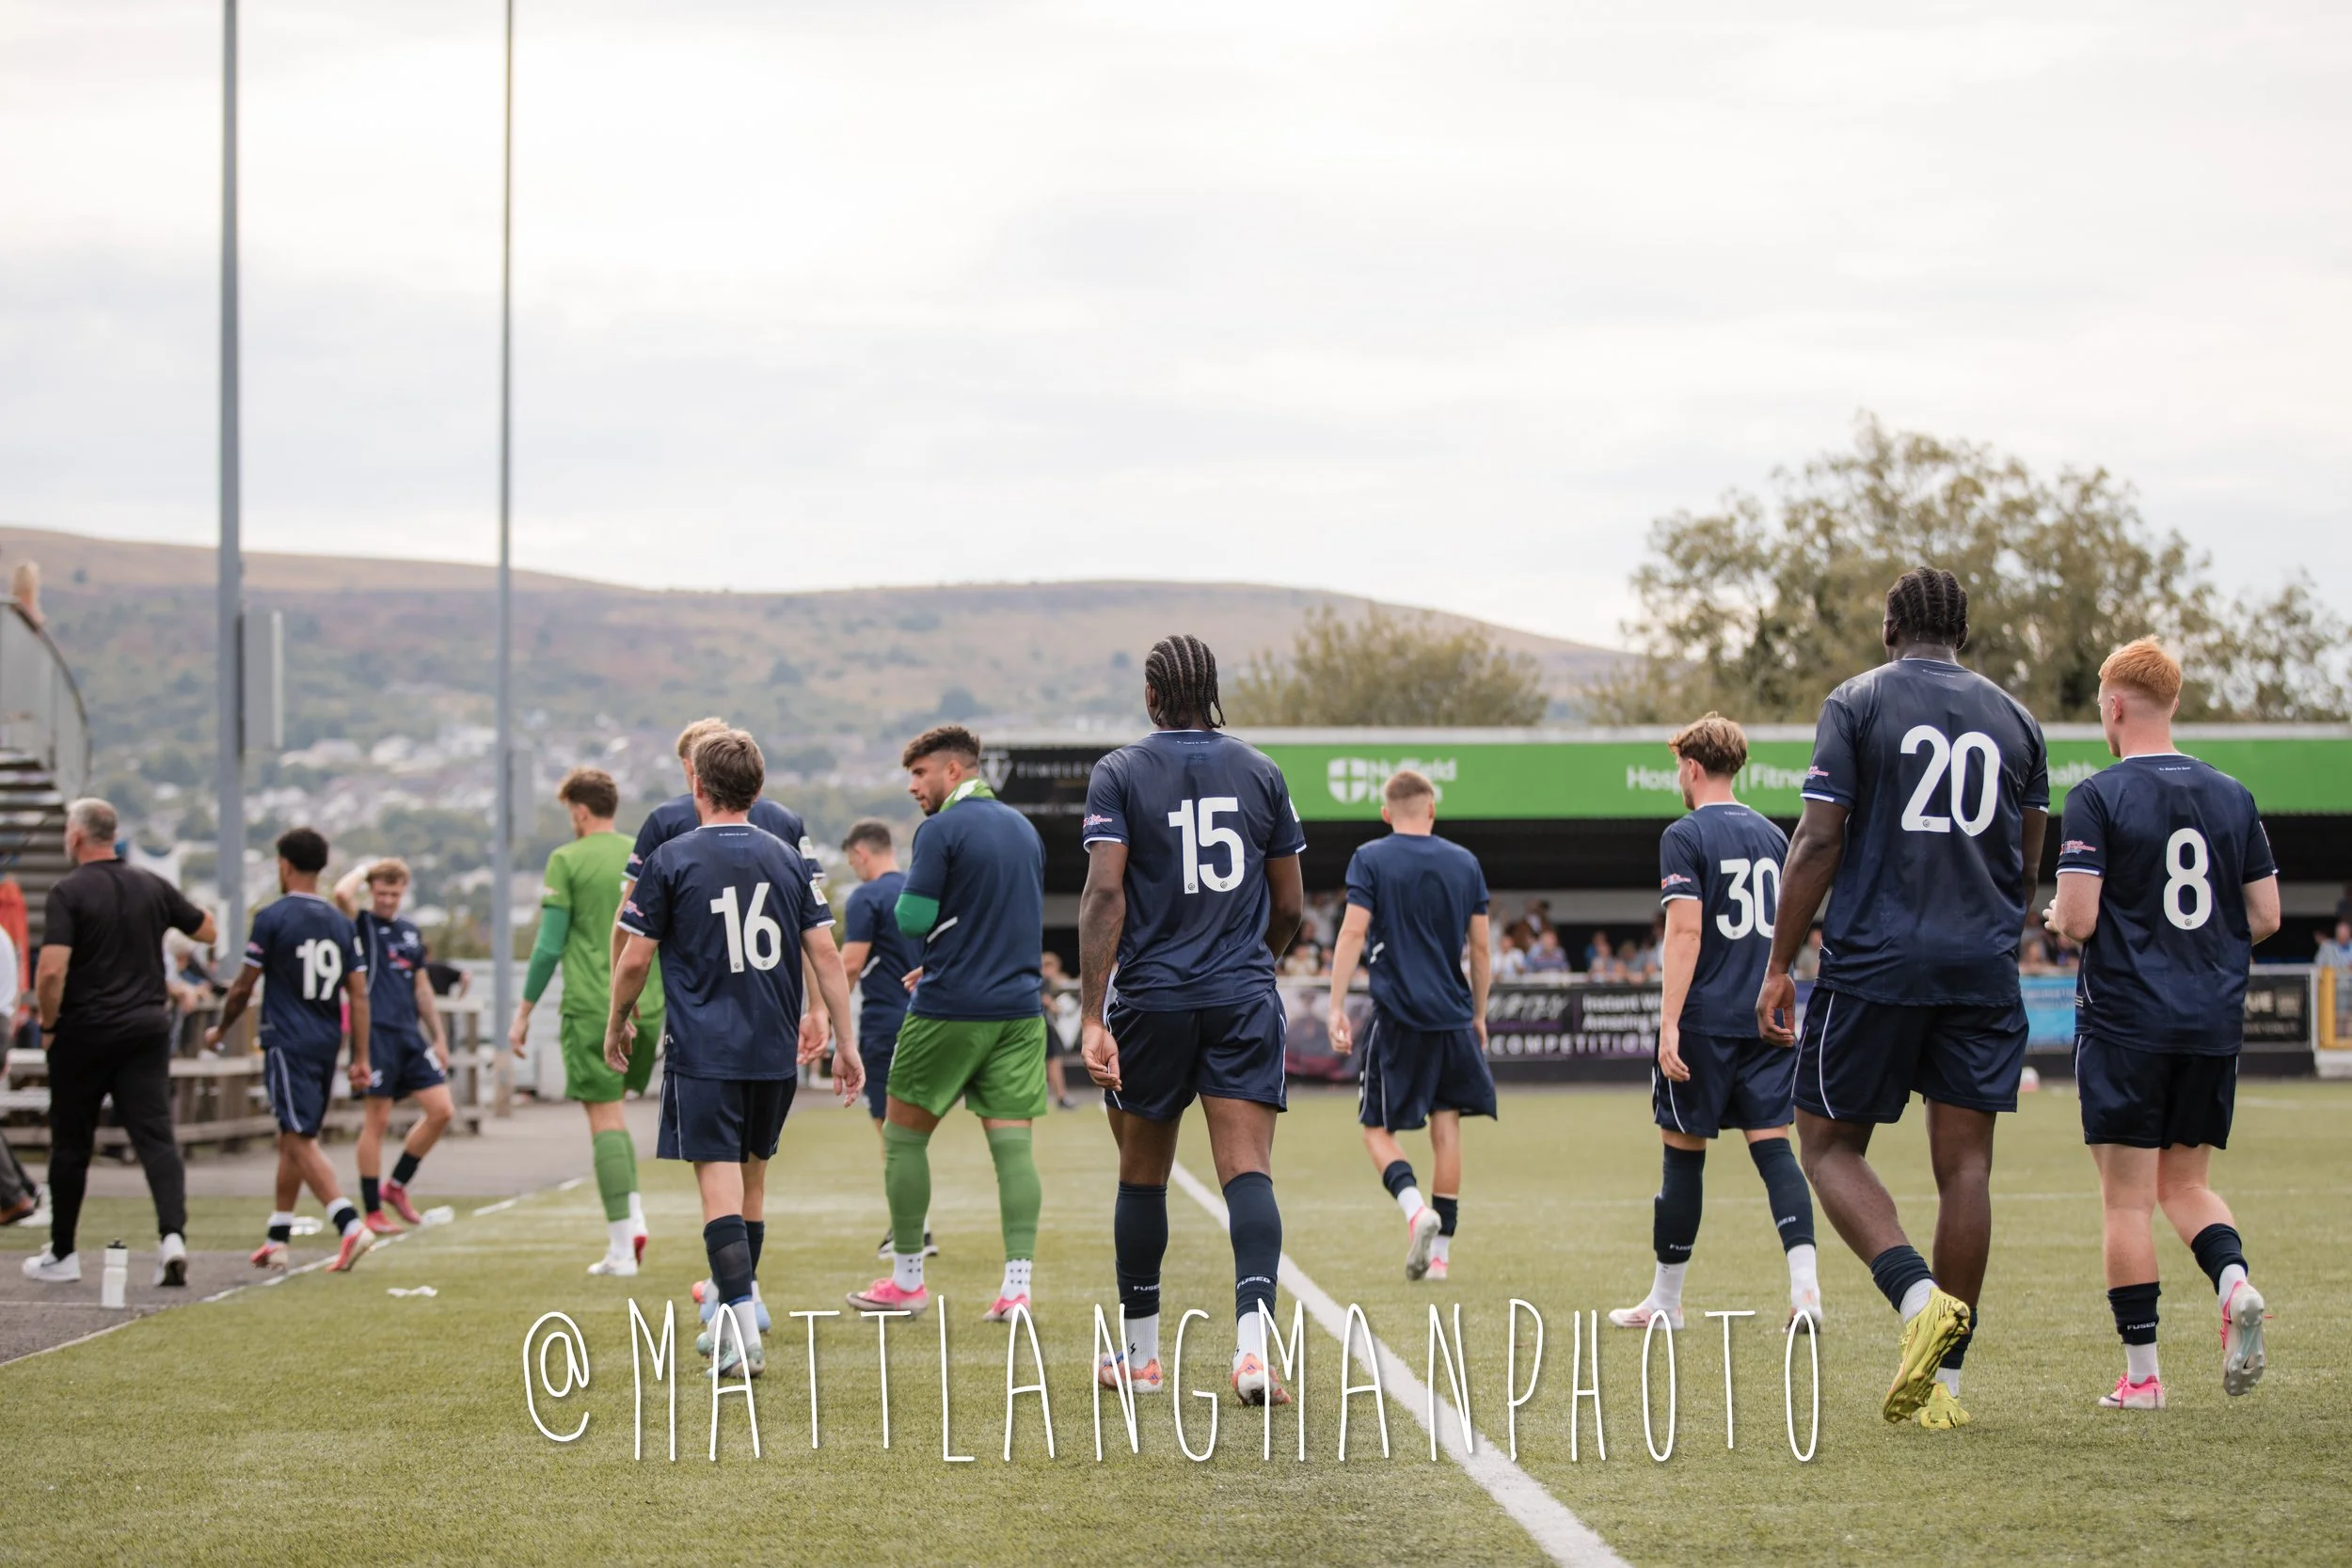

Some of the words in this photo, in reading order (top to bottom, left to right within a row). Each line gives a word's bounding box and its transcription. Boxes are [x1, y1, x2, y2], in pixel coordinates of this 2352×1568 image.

[1016, 761, 1093, 779] TIMELES
[1900, 725, 2001, 837] 20
[1168, 797, 1245, 894] 15
[2164, 829, 2211, 929] 8
[709, 882, 782, 974] 16
[1716, 857, 1780, 940] 30
[295, 939, 342, 1001] 19
[1490, 1034, 1655, 1054] COMPETITION
[1236, 1276, 1270, 1290] FUSED
